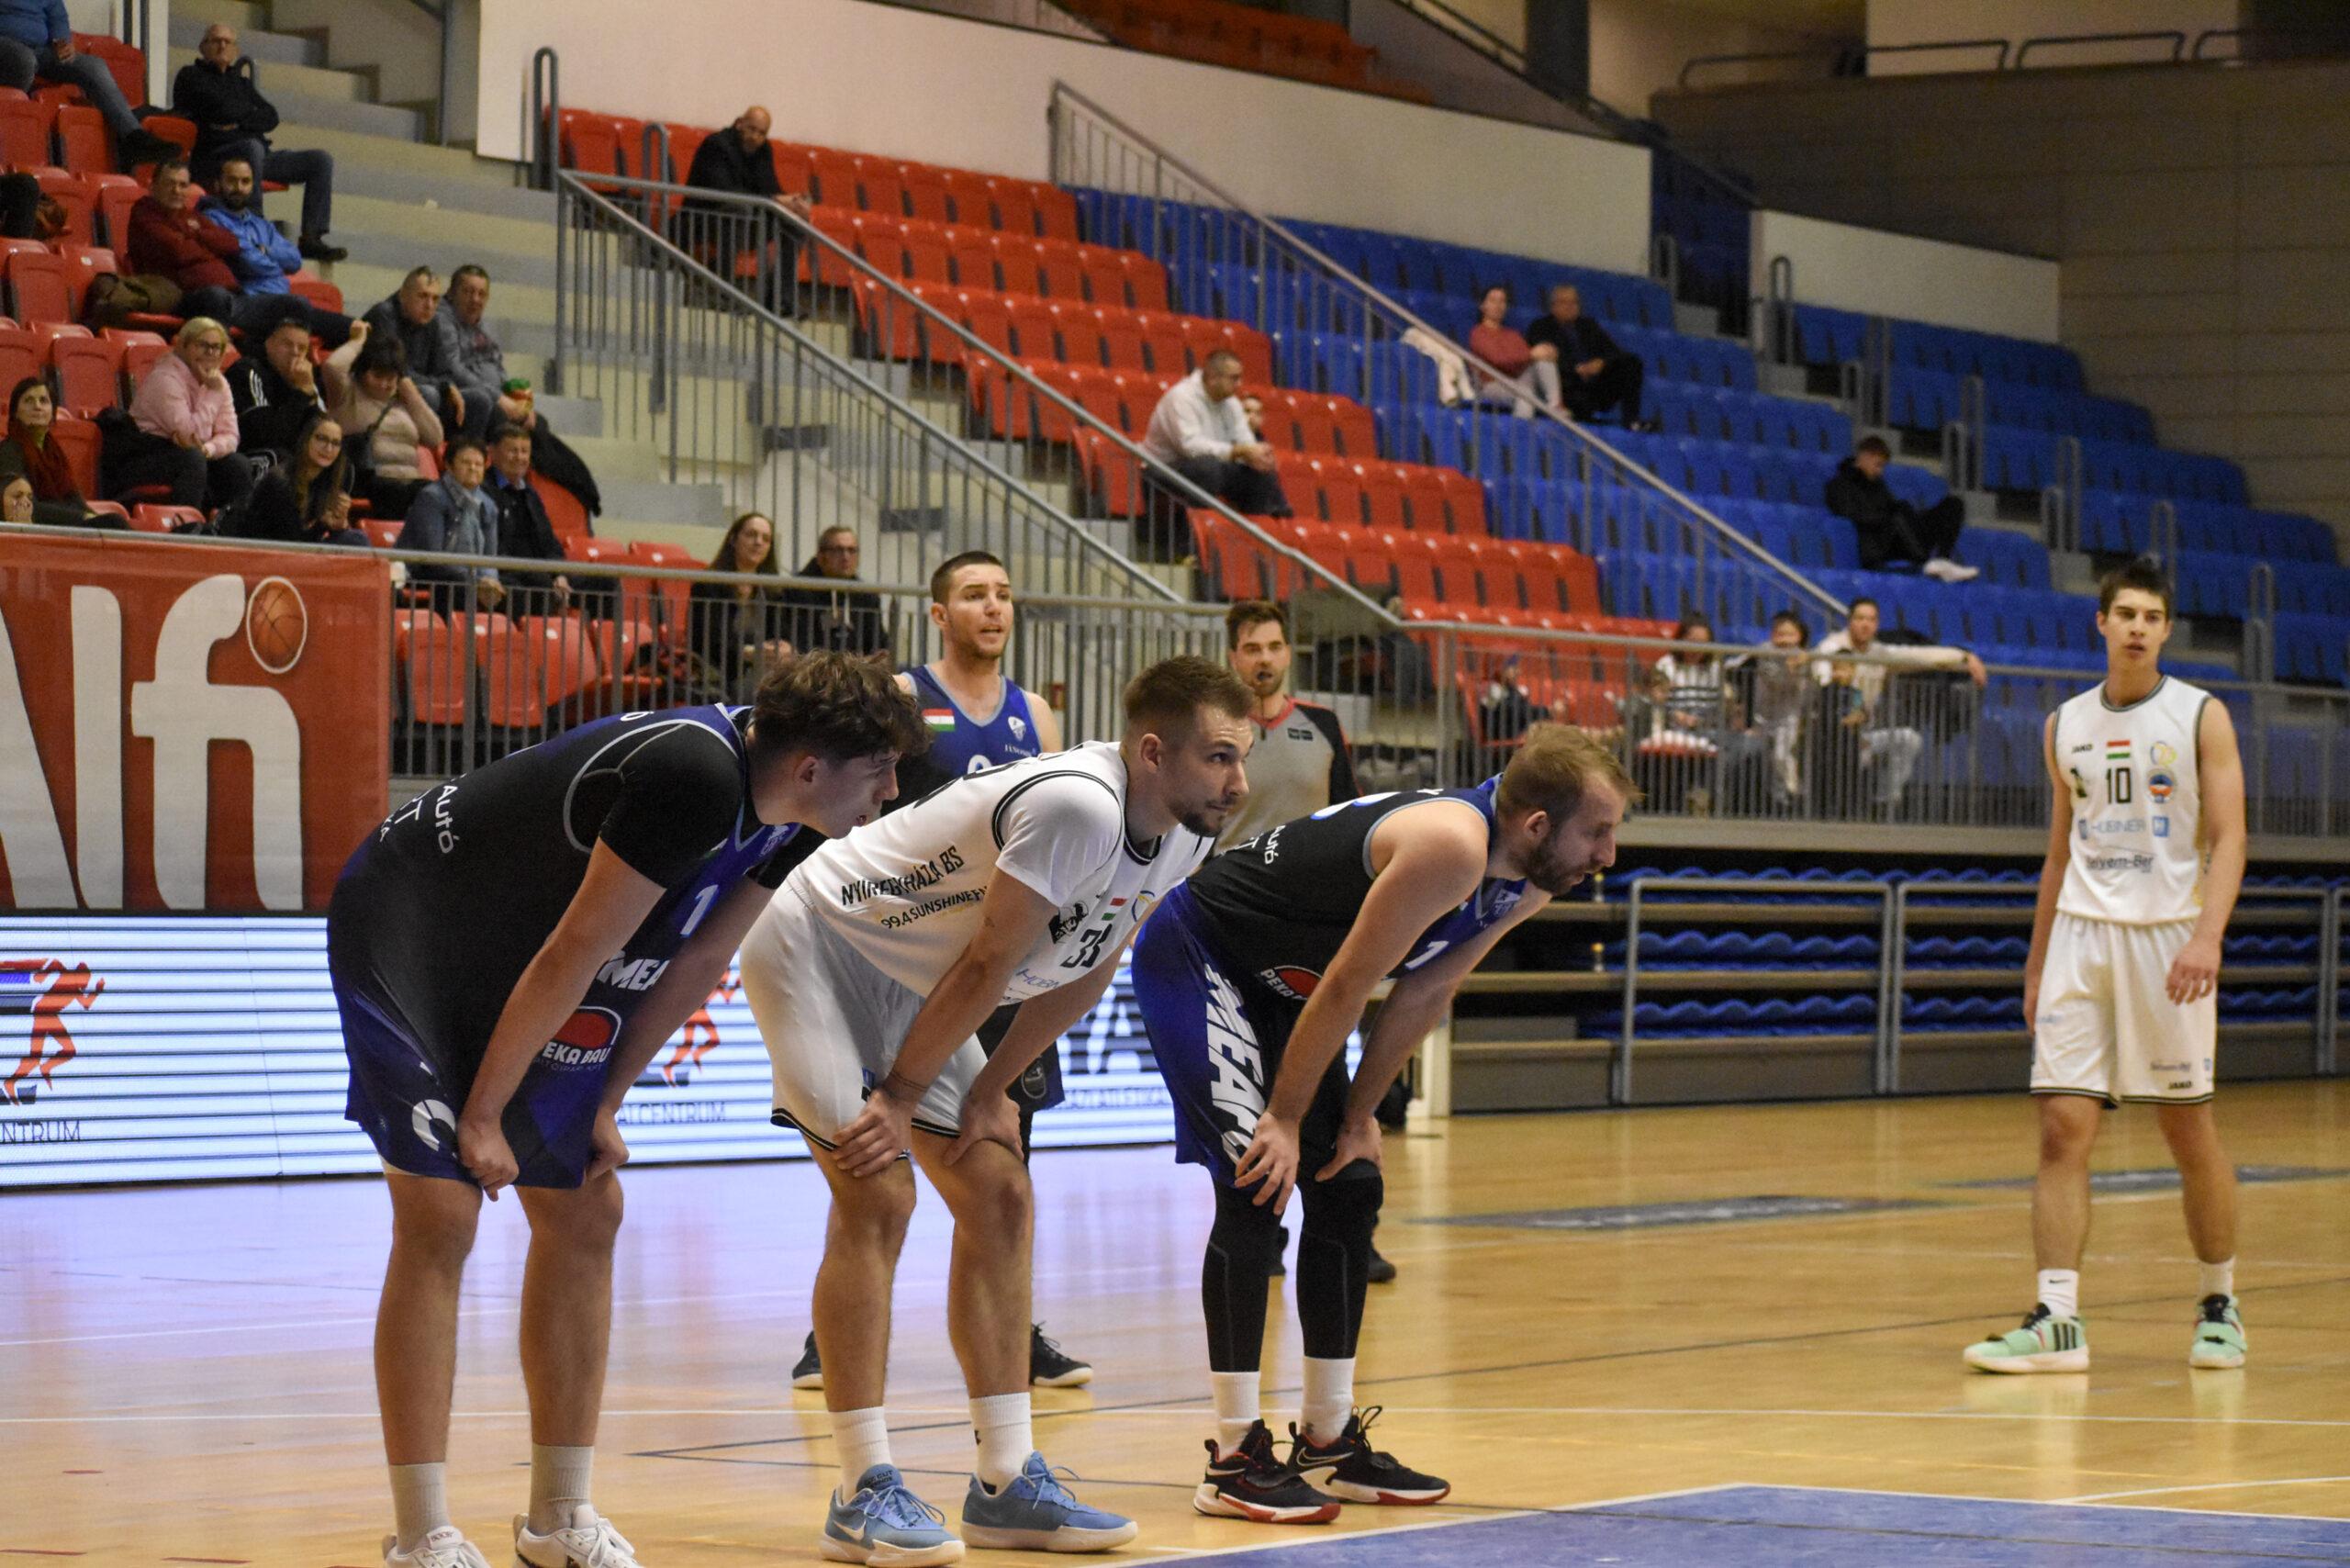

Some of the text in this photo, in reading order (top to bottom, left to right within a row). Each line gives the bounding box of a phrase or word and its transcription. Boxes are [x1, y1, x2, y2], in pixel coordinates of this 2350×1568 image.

[2106, 767, 2131, 804] 10
[939, 846, 965, 875] BS
[542, 1041, 611, 1065] EKA BAU
[0, 1119, 82, 1143] NTRUM
